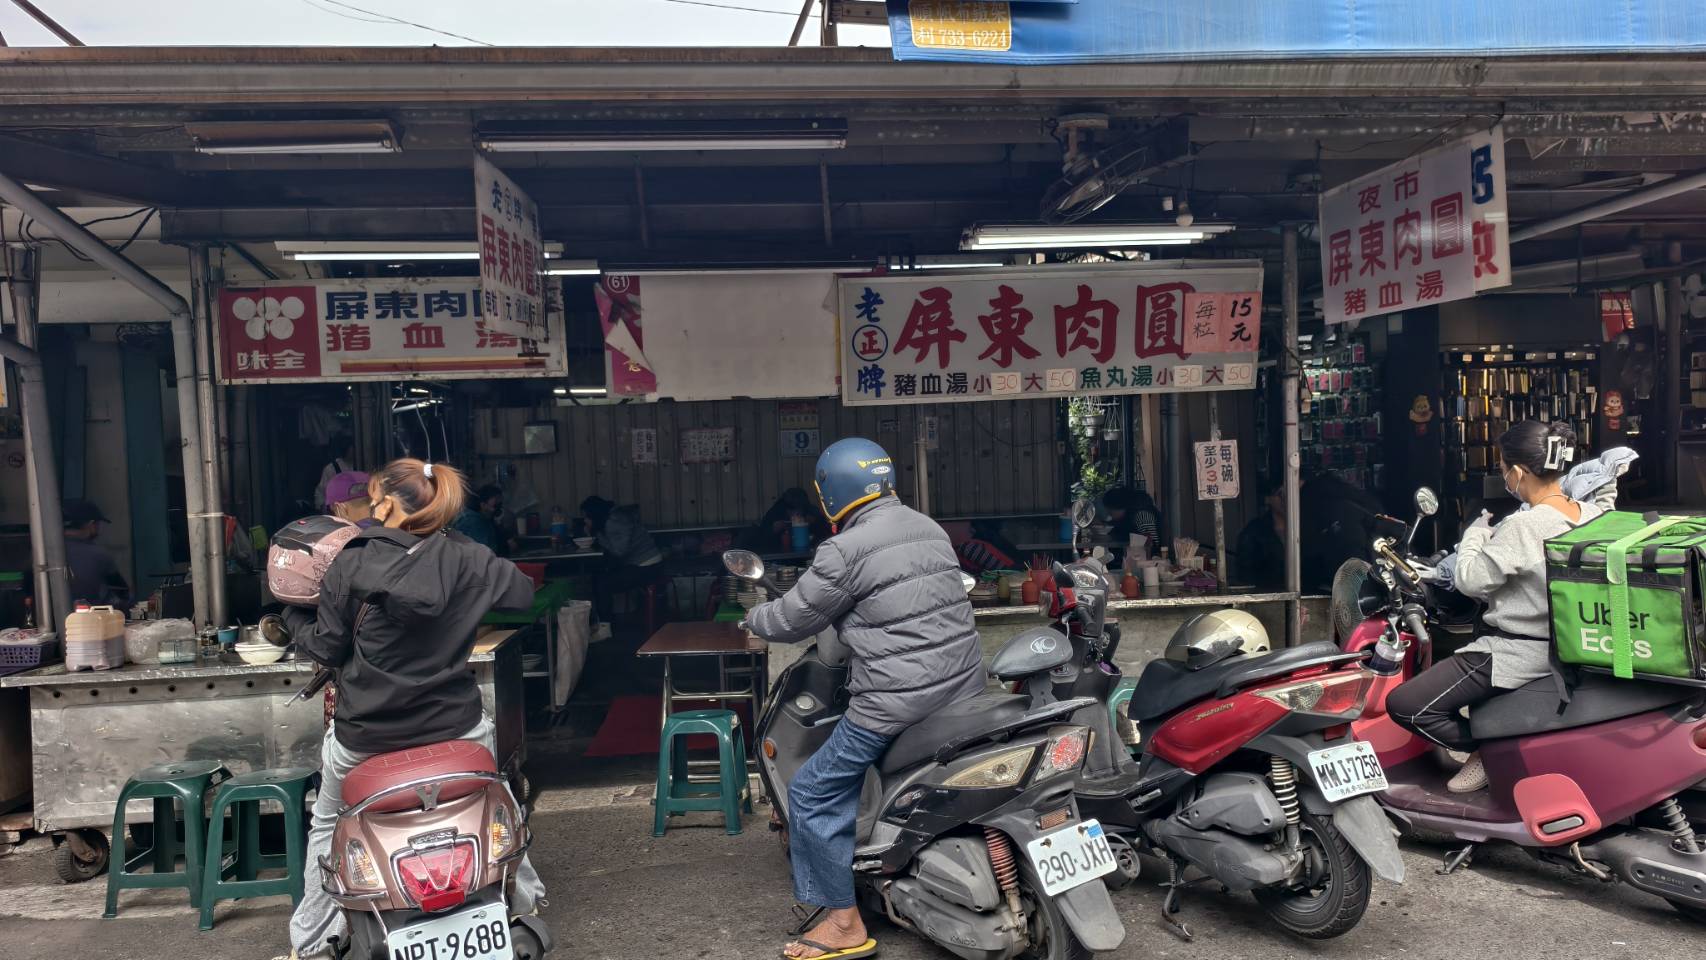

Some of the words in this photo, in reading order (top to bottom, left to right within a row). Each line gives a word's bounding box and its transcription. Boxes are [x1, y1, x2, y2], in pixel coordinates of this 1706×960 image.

[938, 29, 1008, 47] 733-6224
[1357, 170, 1420, 215] 夜市
[1328, 191, 1465, 287] 屏東肉圓
[610, 275, 627, 288] 61
[1344, 269, 1444, 316] 豬血湯
[325, 289, 482, 320] 屏東肉
[1192, 299, 1218, 339] 每粒
[893, 281, 1197, 370] 屏東肉圓
[236, 349, 306, 371] 味全
[894, 372, 969, 396] 豬血湯
[1080, 366, 1153, 390] 魚丸湯
[795, 431, 810, 449] 9
[1203, 445, 1219, 496] 至少3粒
[1219, 444, 1234, 482] 每碗
[1580, 627, 1653, 658] Eas
